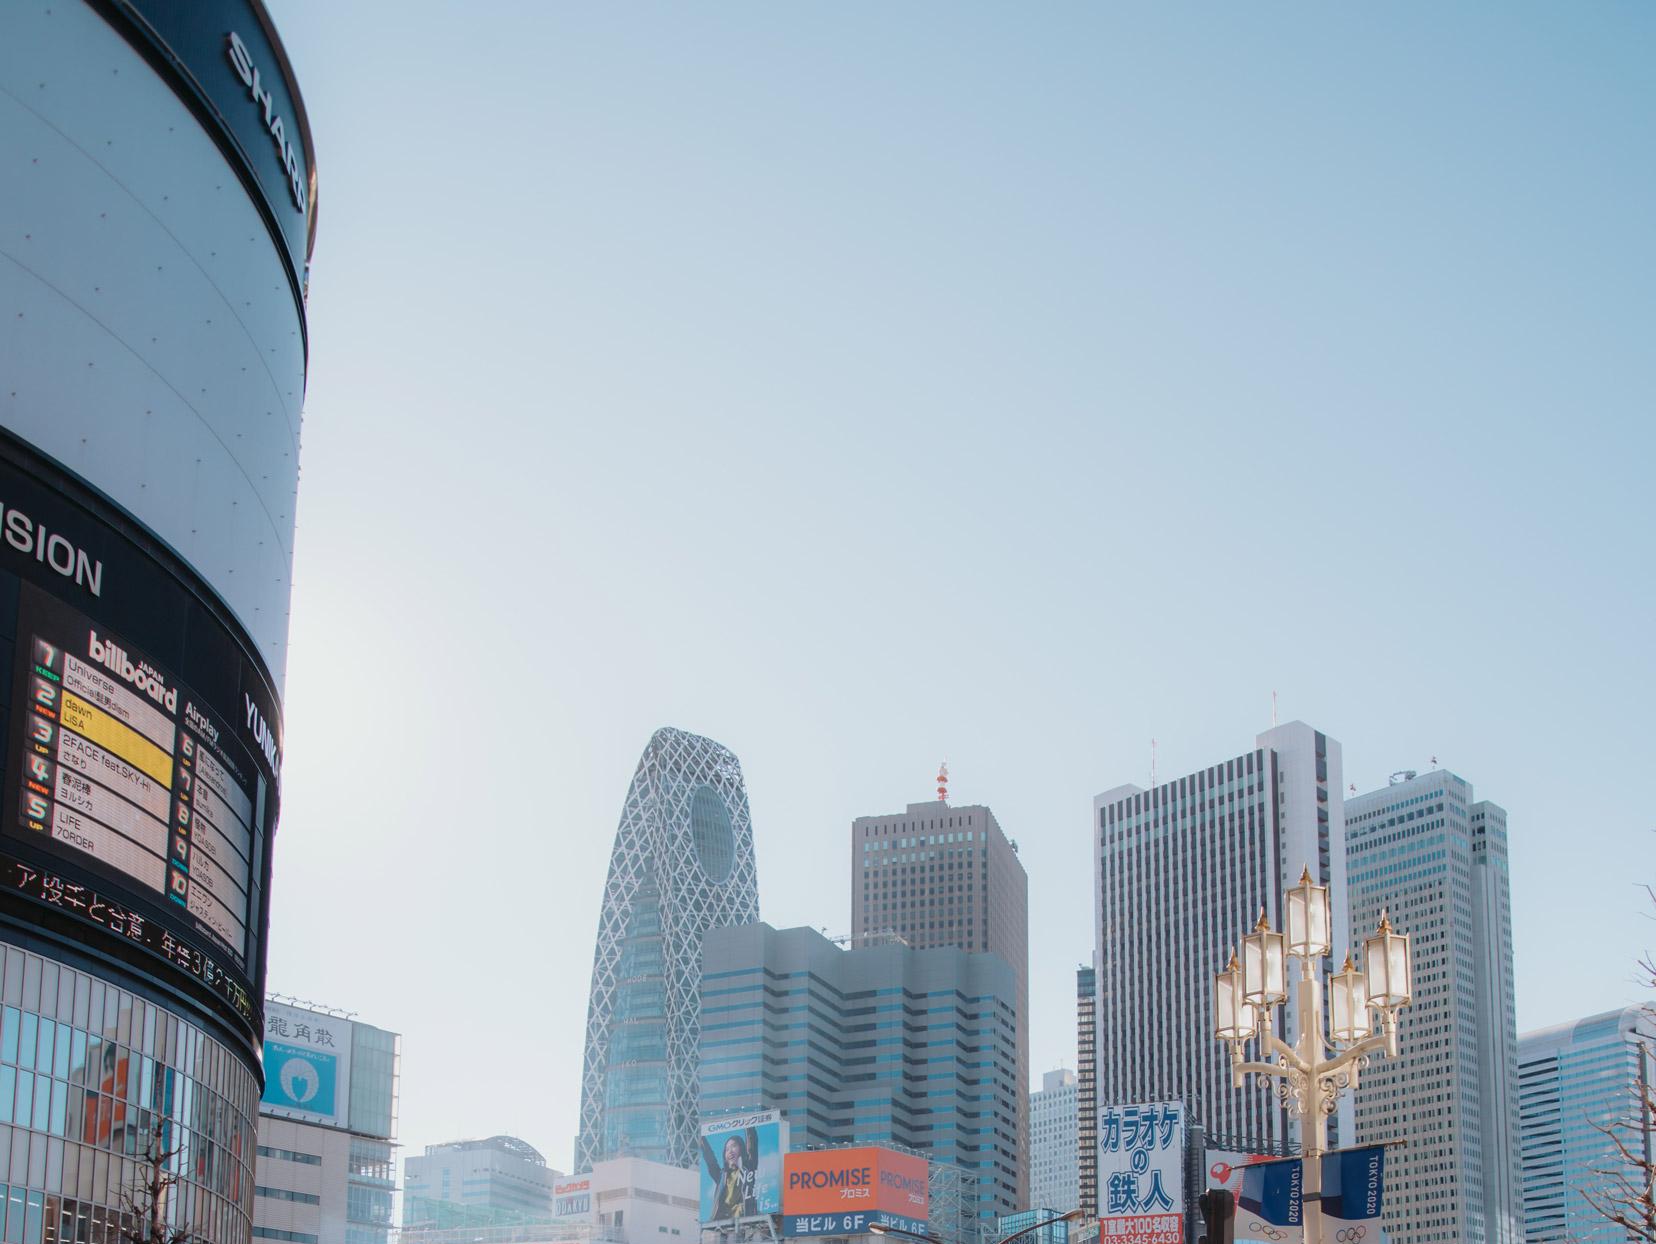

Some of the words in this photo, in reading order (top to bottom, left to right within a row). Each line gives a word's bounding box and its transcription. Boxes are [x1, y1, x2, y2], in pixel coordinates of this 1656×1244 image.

[36, 665, 59, 681] KEEP
[68, 658, 115, 695] Universe
[89, 629, 178, 715] billboard
[138, 660, 164, 684] JAPAN
[36, 683, 56, 707] 2
[35, 704, 56, 719] NEW
[65, 698, 93, 720] dawn
[33, 720, 53, 743] 3
[185, 701, 219, 743] Airplay
[34, 744, 49, 754] UP
[62, 734, 99, 762] 2FACE
[182, 737, 193, 757] 6
[31, 756, 49, 782] 4
[63, 751, 87, 770] さなり
[28, 780, 49, 795] NEW
[181, 770, 191, 791] 7
[26, 795, 48, 819] 5
[61, 787, 93, 811] ヨルシカ
[29, 820, 43, 831] UP
[59, 811, 81, 831] LIFE
[177, 805, 190, 825] 8
[176, 839, 187, 860] 9
[171, 870, 187, 896] 10
[268, 1015, 335, 1048] 龍角散
[1101, 1103, 1180, 1153] カラオケ
[1130, 1147, 1149, 1175] の
[1367, 1155, 1379, 1190] TOKYO
[555, 1180, 590, 1195] ビックカメラ
[737, 1168, 765, 1186] New
[790, 1168, 871, 1190] PROMISE
[880, 1170, 925, 1195] PROMISE
[1290, 1166, 1300, 1201] TOKYO
[840, 1188, 871, 1199] プロミス
[908, 1193, 925, 1205] プロミス
[1107, 1169, 1174, 1214] 鉄人
[1366, 1191, 1377, 1215] 2020
[555, 1197, 589, 1217] ODAKYU
[1288, 1200, 1299, 1223] 2020
[796, 1216, 836, 1232] 当ビル
[843, 1215, 864, 1230] 6F
